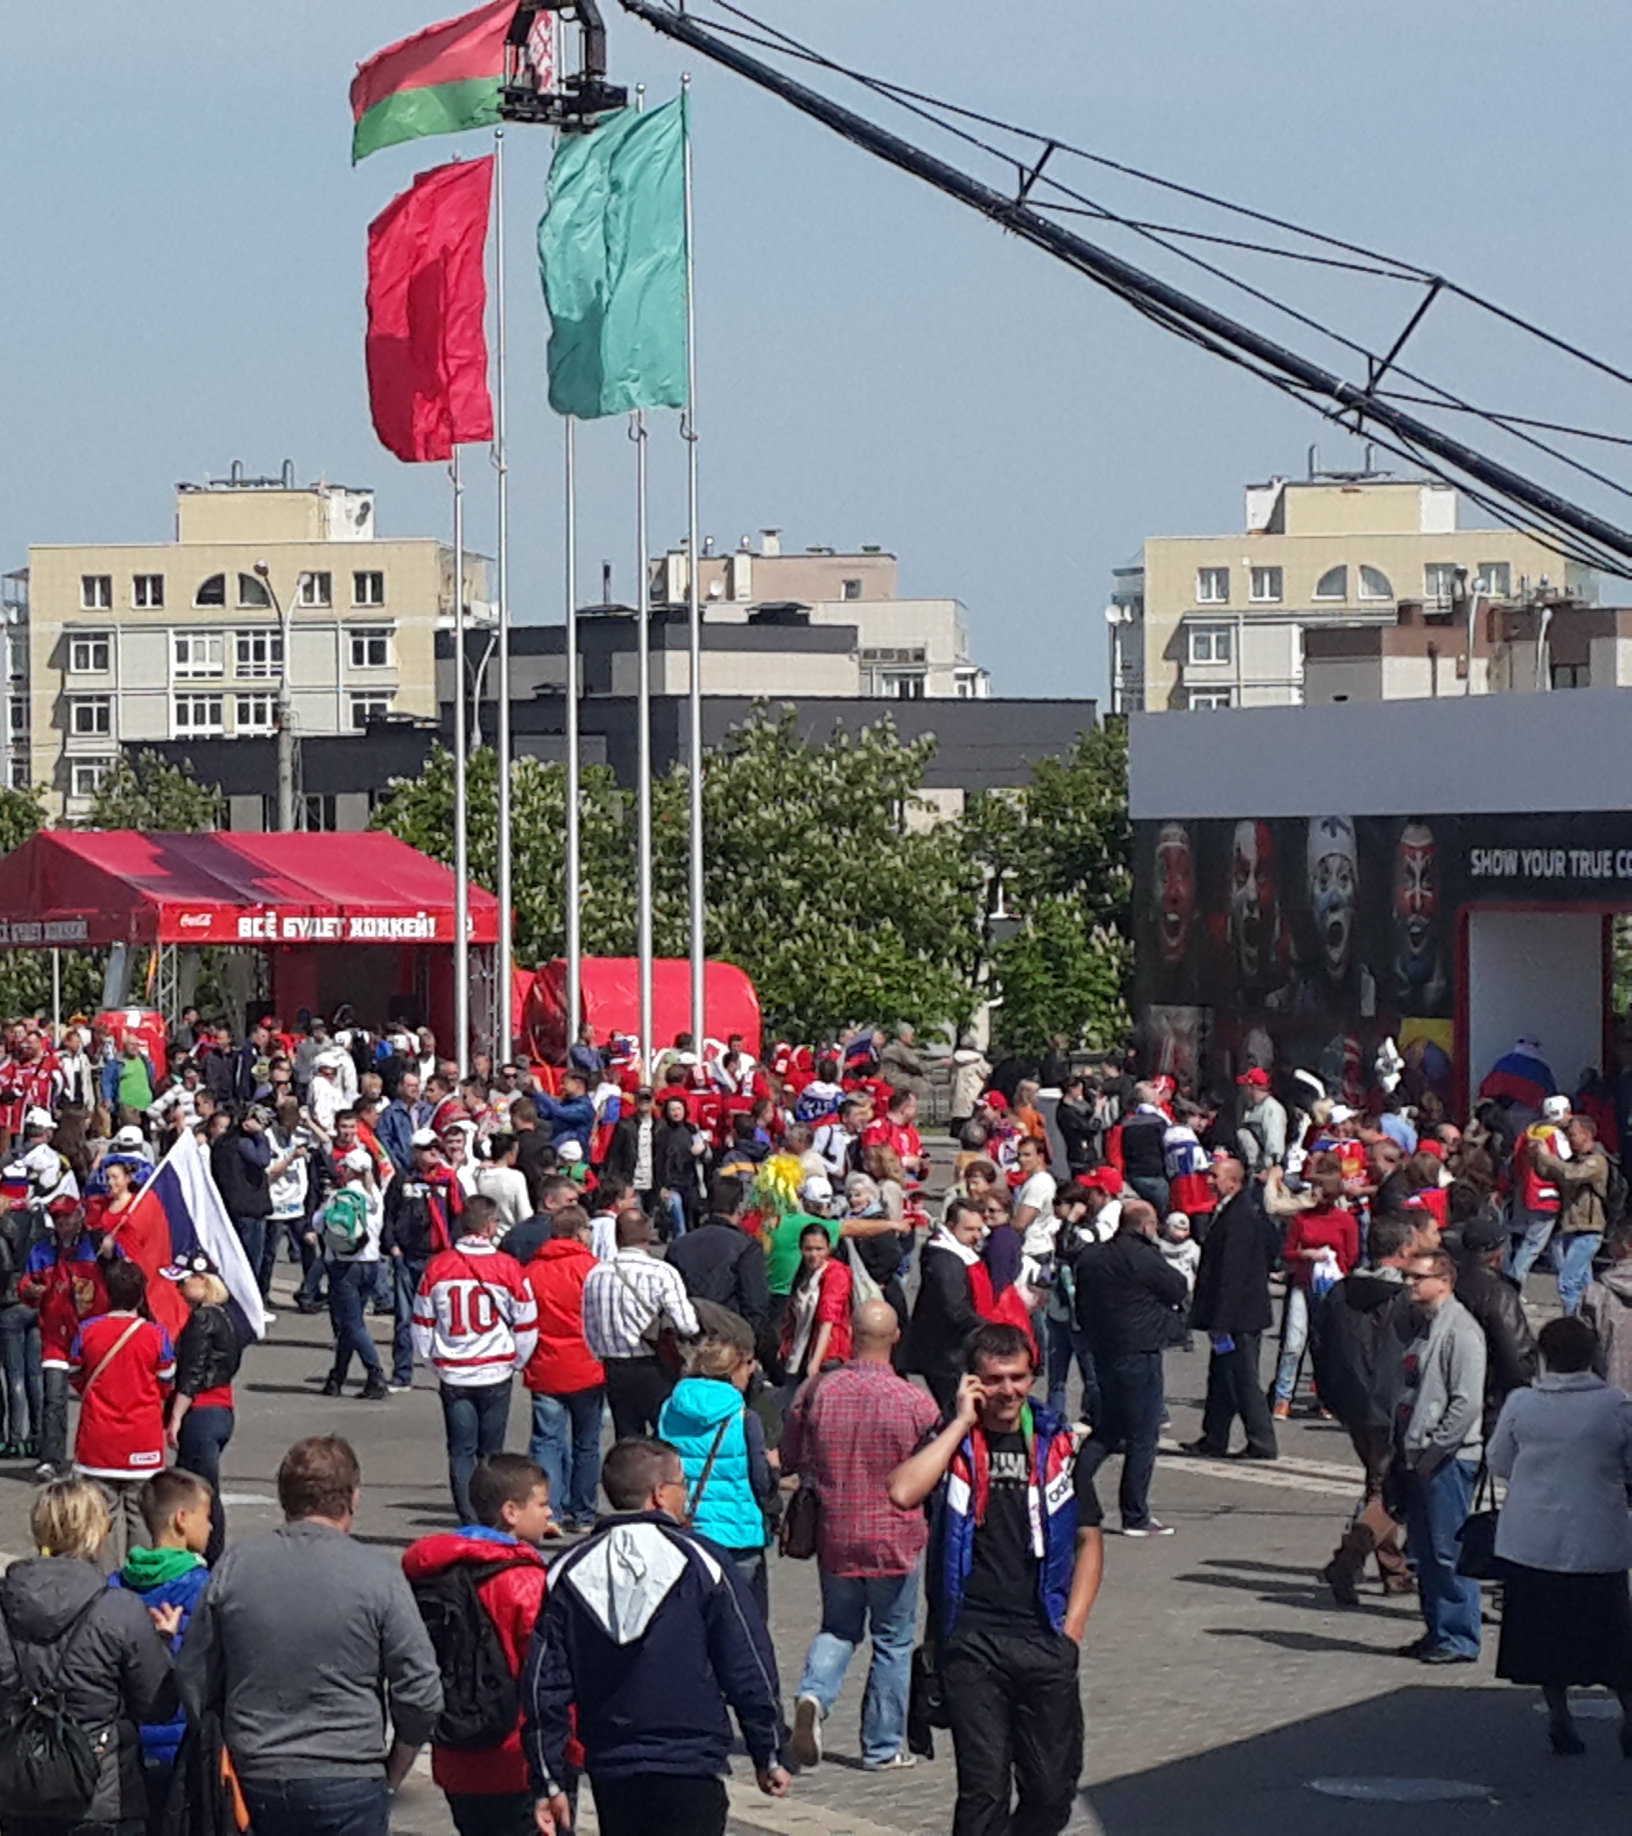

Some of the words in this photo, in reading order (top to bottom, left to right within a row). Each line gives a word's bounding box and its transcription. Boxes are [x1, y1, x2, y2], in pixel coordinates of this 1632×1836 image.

[1471, 849, 1518, 876] SHOW
[1520, 850, 1566, 877] YOUR
[1568, 850, 1613, 878] TRUE
[238, 911, 277, 937] ВСЁ
[283, 916, 345, 938] БУДЕТ
[448, 1285, 501, 1337] 10
